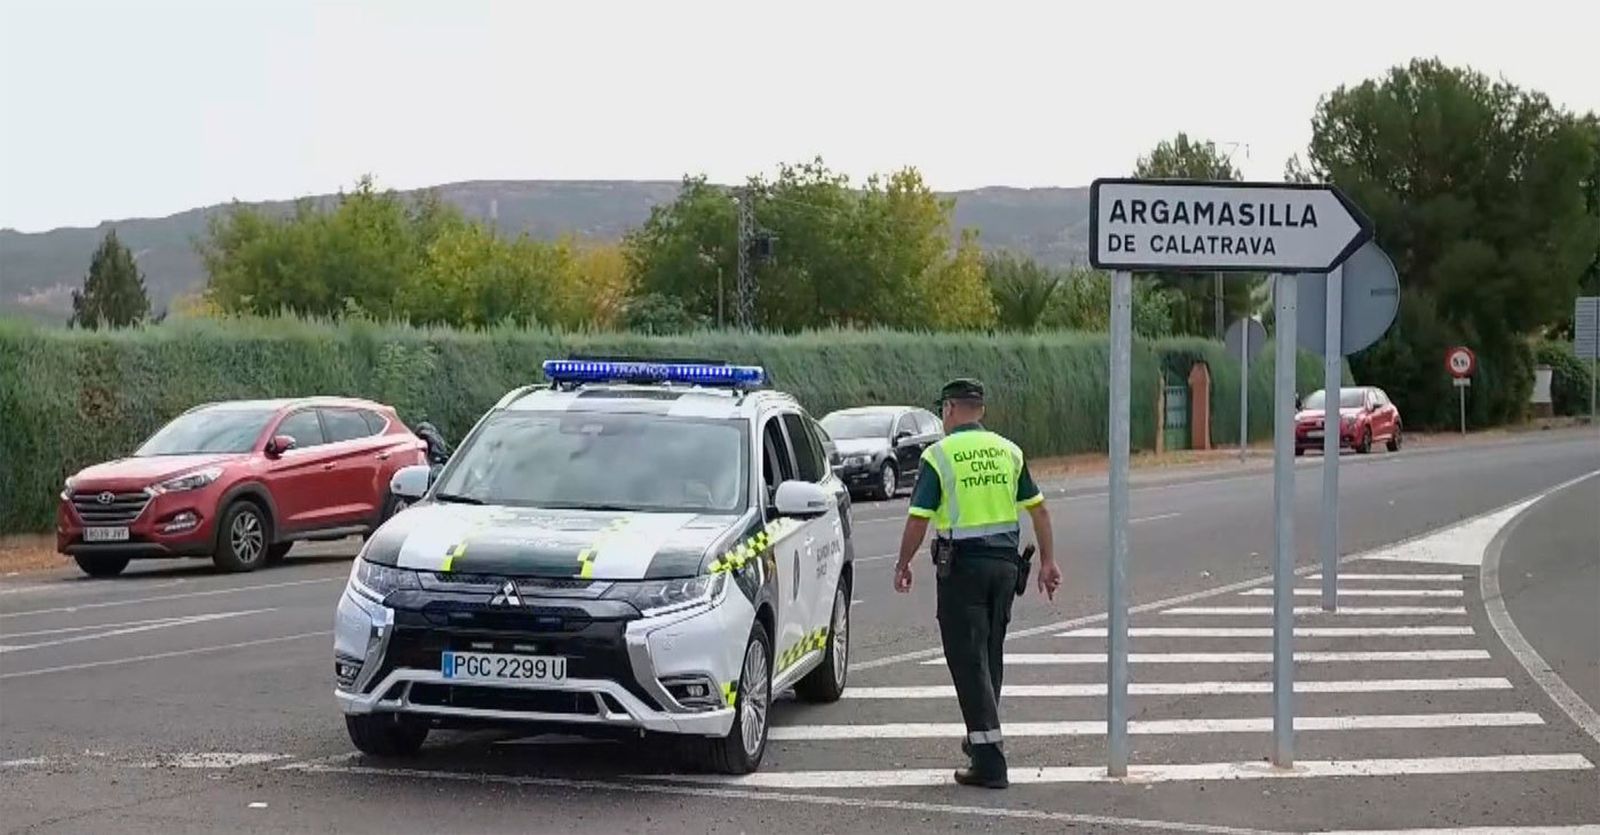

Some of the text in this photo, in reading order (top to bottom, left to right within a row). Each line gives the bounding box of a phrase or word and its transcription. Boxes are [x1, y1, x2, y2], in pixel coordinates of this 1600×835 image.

[1108, 199, 1318, 228] ARGAMASILLA
[1107, 234, 1276, 256] DE CALATRAVA
[953, 447, 1006, 463] GUARDIA
[971, 460, 999, 472] CIVIL
[454, 655, 565, 681] PGC 2299 U
